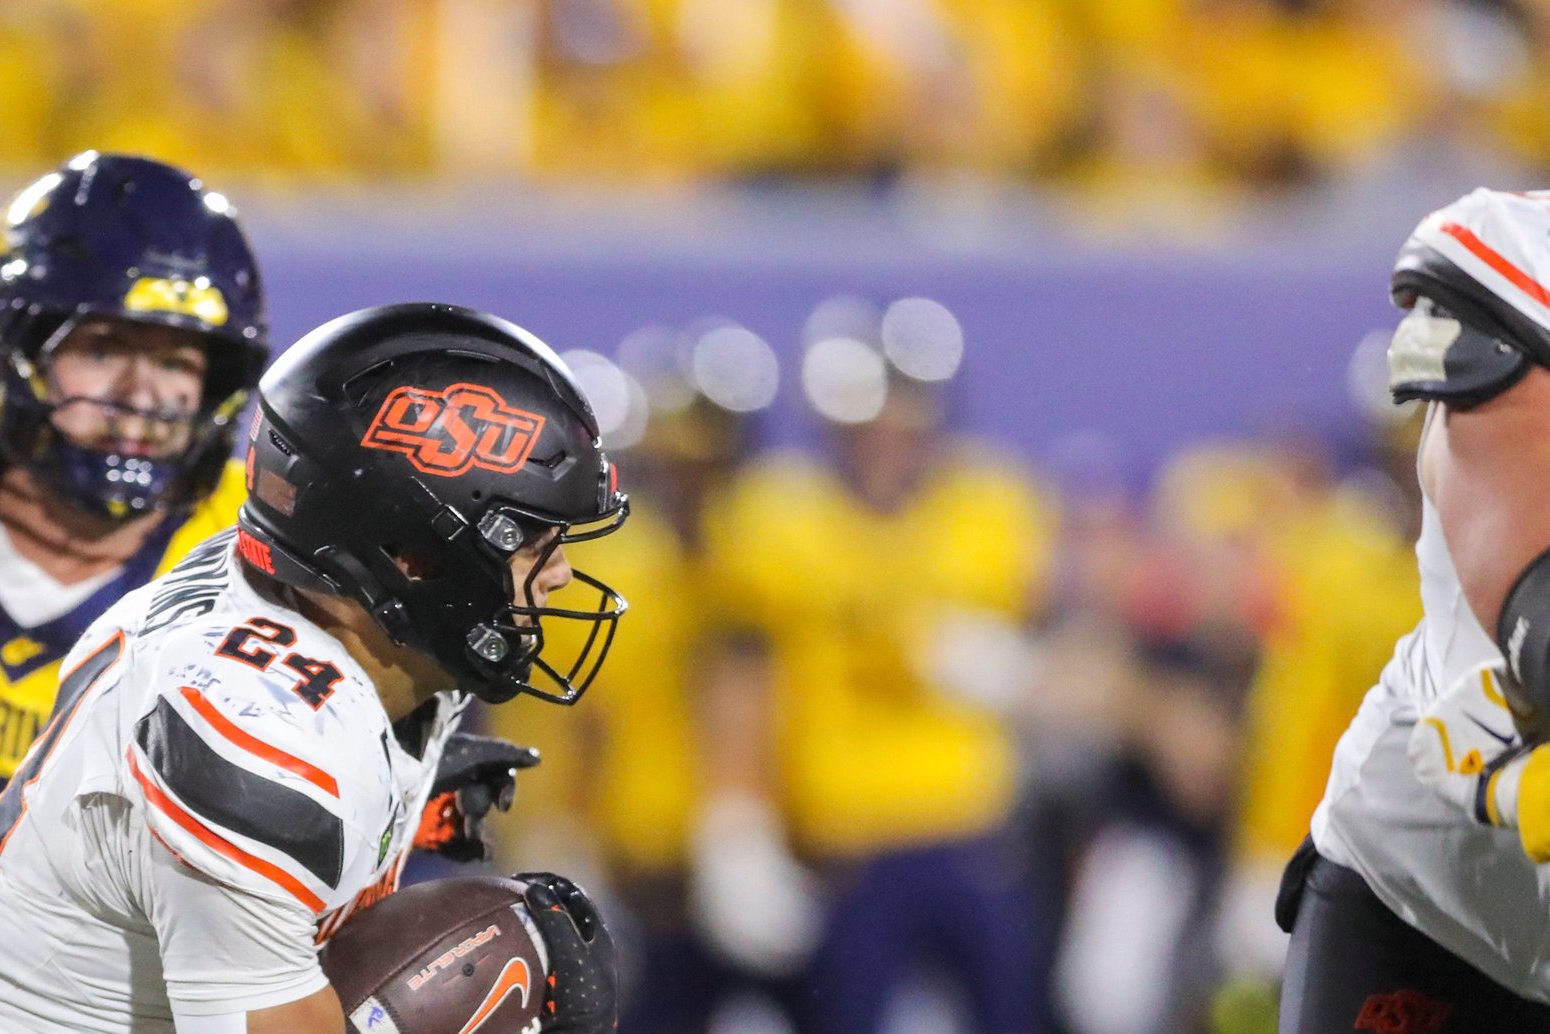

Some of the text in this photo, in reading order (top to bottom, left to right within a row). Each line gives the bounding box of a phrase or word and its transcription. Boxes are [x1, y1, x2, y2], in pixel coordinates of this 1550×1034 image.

[361, 383, 546, 478] OSU
[214, 616, 345, 712] 24
[407, 950, 455, 991] ELITE
